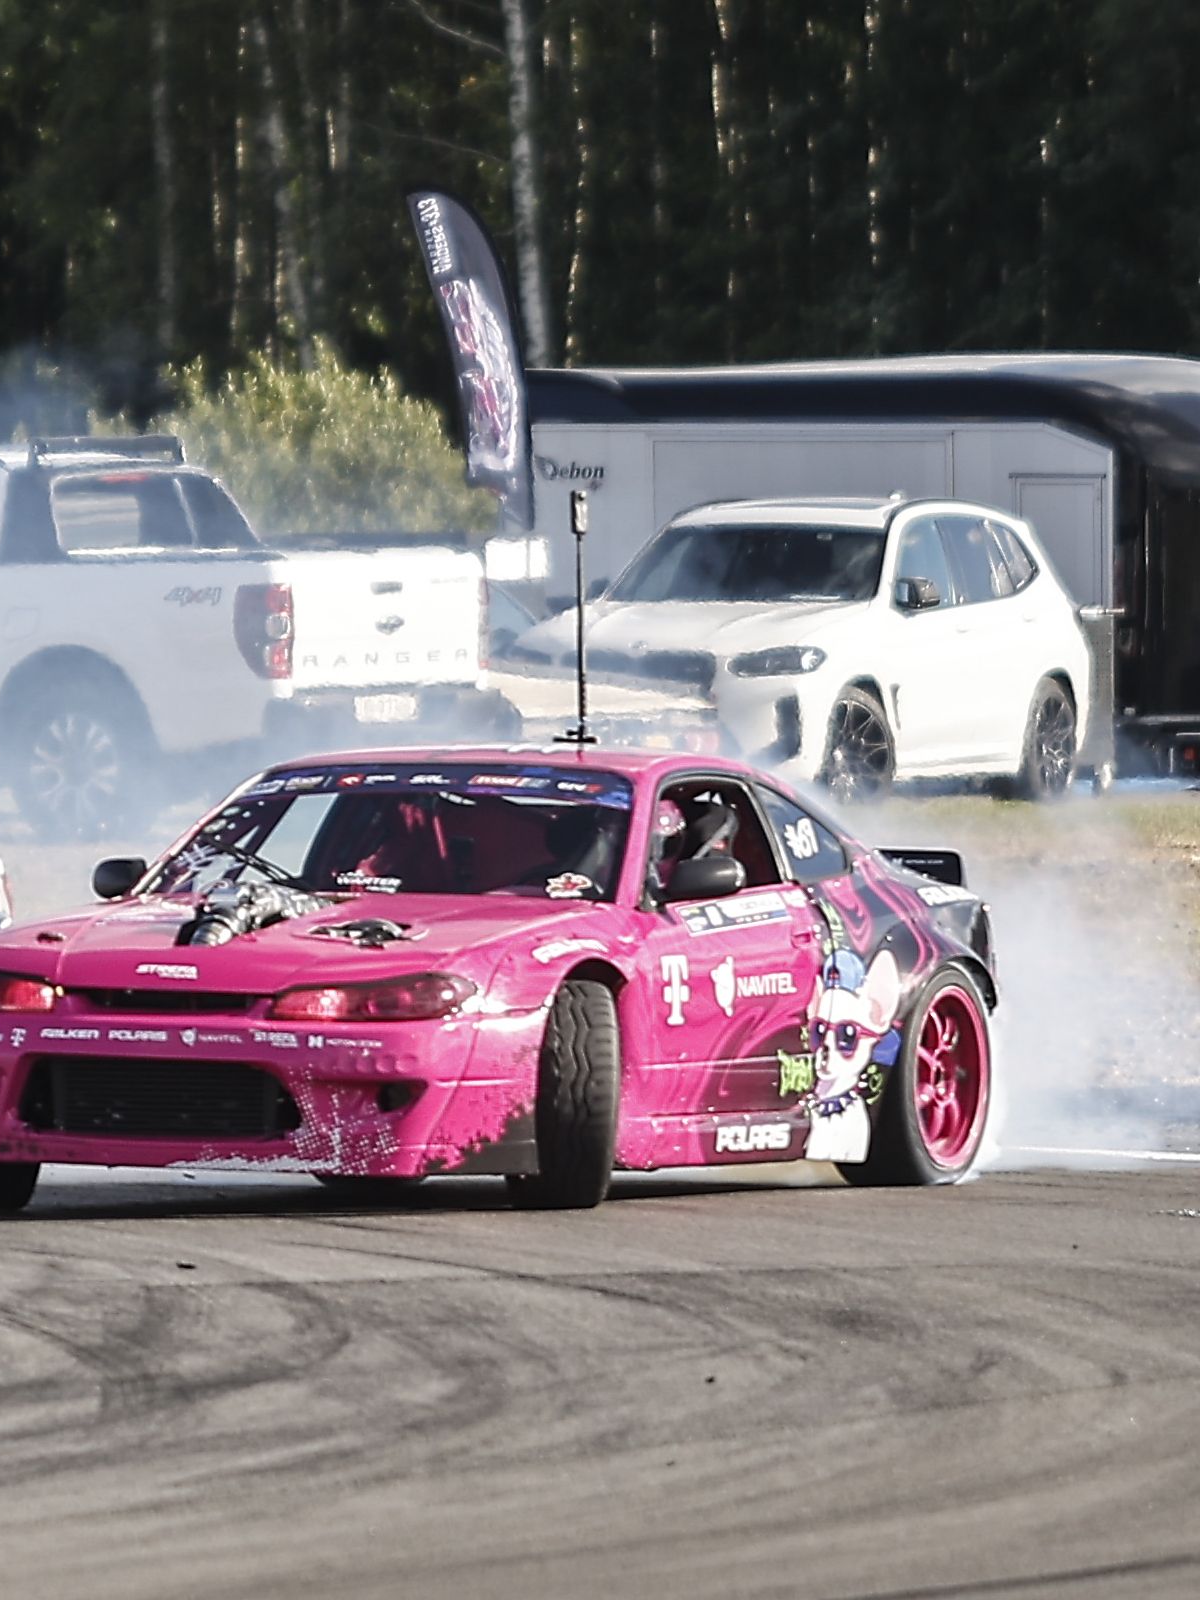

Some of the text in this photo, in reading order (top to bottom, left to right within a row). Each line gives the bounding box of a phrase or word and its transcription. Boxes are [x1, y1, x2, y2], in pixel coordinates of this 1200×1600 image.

[302, 647, 468, 668] RANGER
[736, 972, 797, 997] NAVITEL
[40, 1028, 99, 1039] FALKEN
[108, 1030, 168, 1042] POLARIS
[198, 1034, 243, 1044] NAVITEL
[715, 1123, 791, 1153] POLARIS
